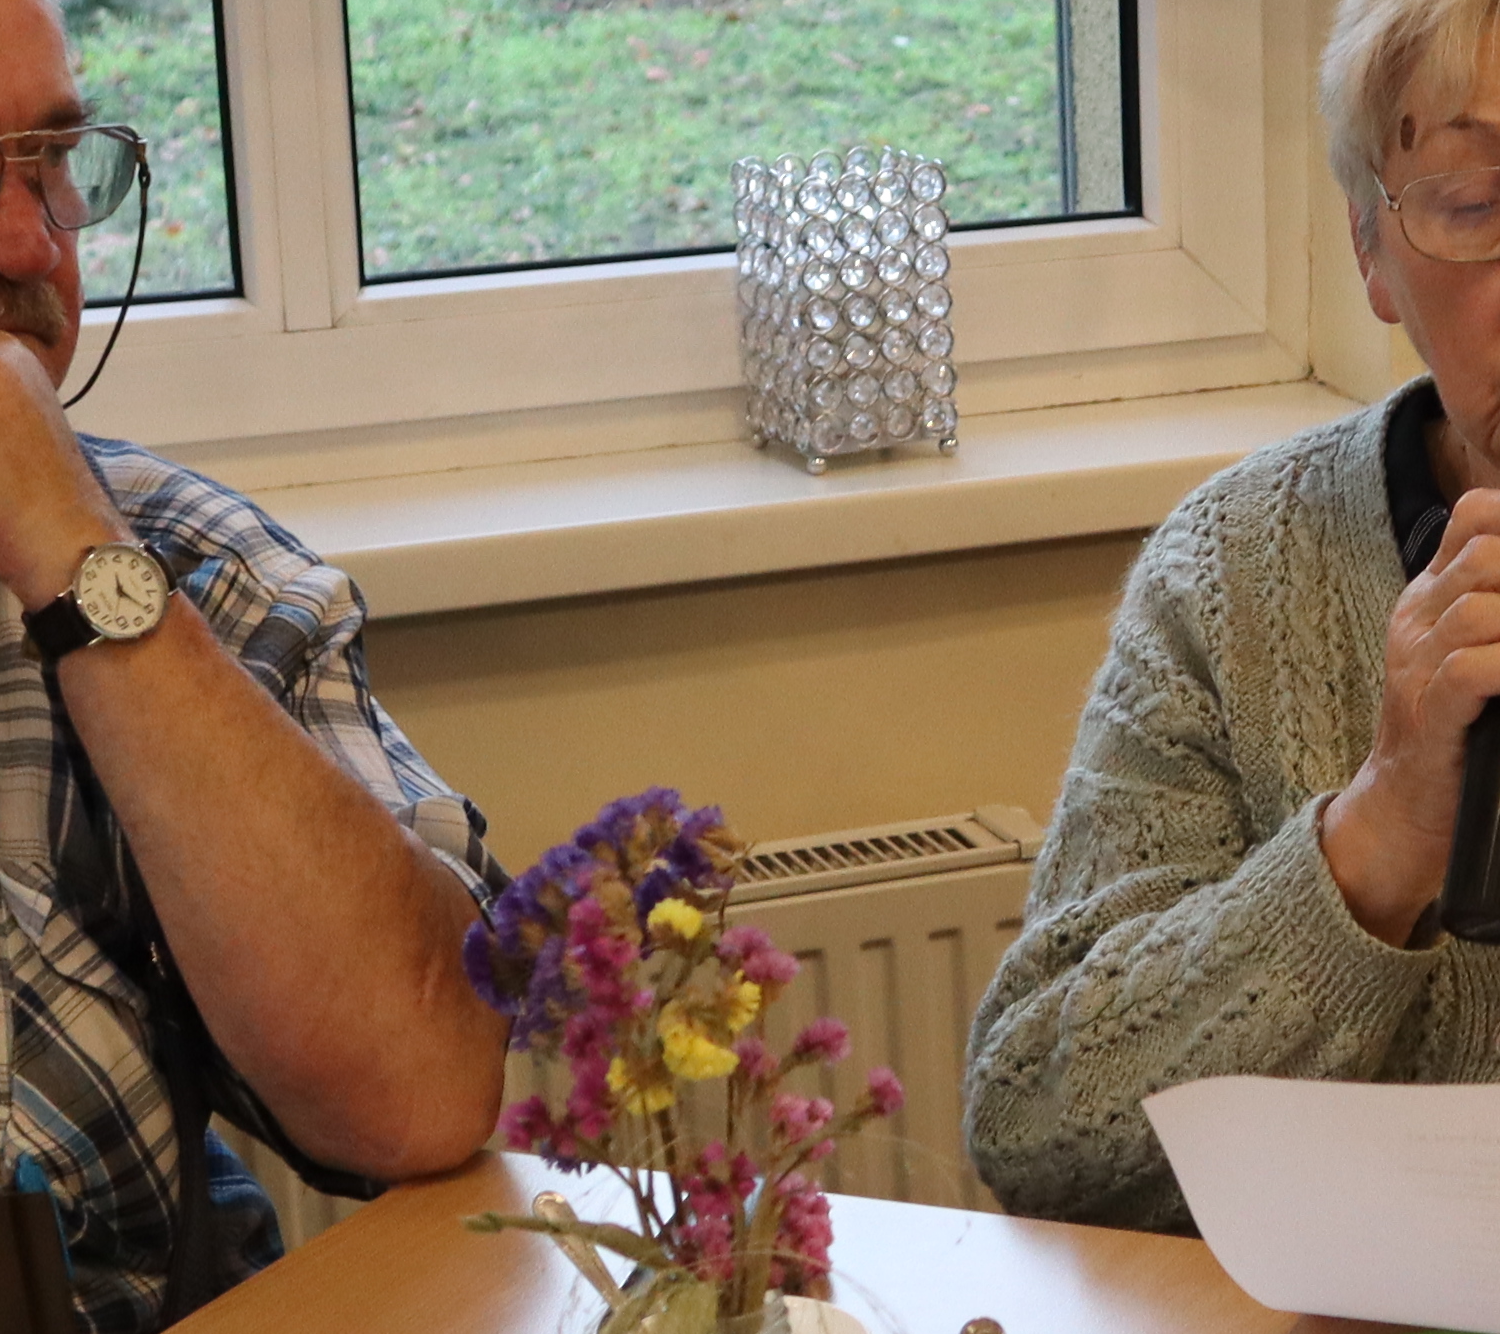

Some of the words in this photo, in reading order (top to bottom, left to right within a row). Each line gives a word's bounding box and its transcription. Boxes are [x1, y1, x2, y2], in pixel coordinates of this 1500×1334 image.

[112, 554, 122, 563] 4
[128, 558, 139, 570] 5
[141, 570, 152, 582] 6
[146, 589, 157, 597] 7
[86, 601, 100, 616] 12
[100, 614, 113, 625] 11
[115, 615, 129, 630] 10
[133, 615, 144, 627] 9
